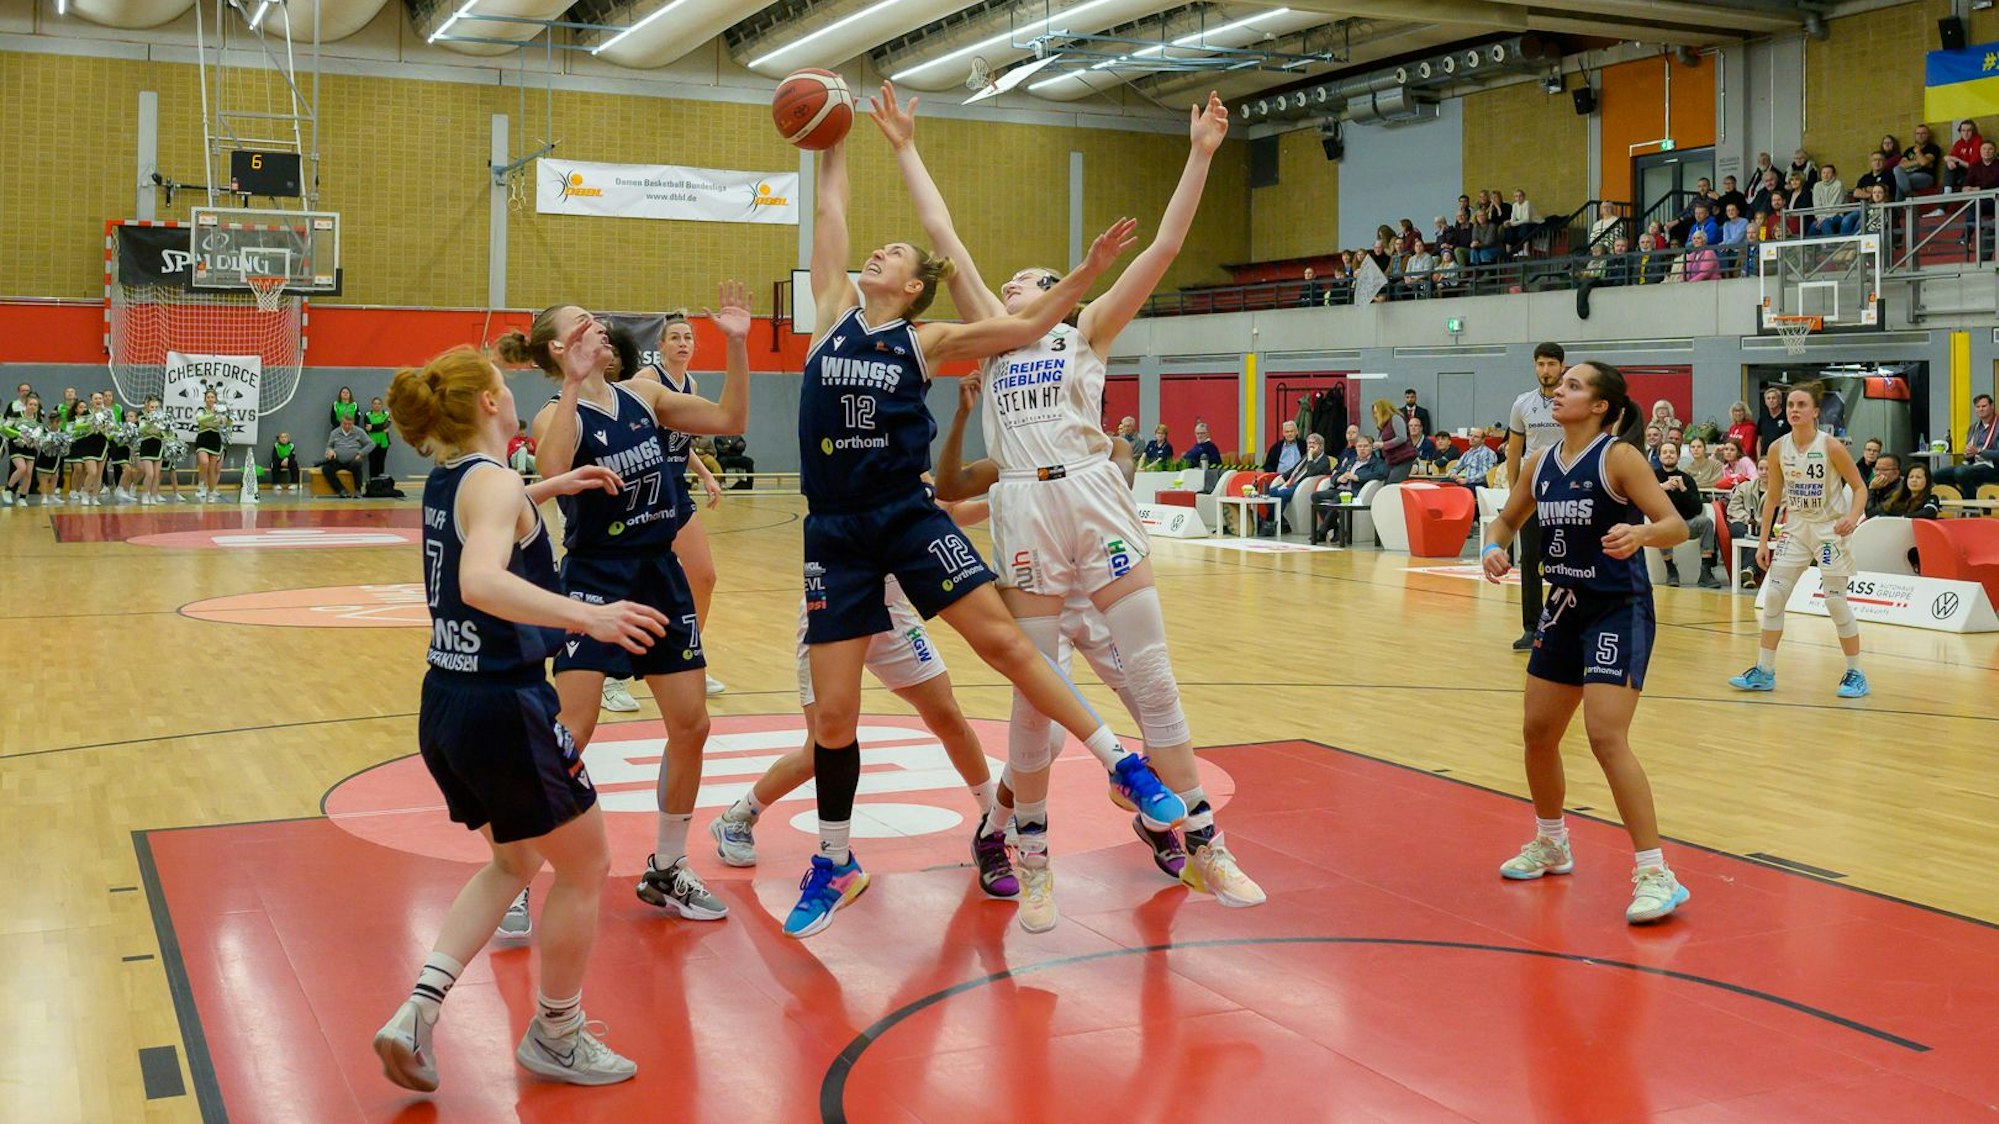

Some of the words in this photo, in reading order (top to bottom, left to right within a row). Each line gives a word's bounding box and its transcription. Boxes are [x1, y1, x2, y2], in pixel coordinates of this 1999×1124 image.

[251, 154, 262, 169] 6
[616, 178, 642, 186] Damen
[644, 179, 684, 188] Basketball
[686, 181, 727, 192] Bundesliga
[646, 193, 697, 202] www.dbbl.de
[1051, 338, 1066, 351] 3
[168, 362, 258, 388] CHEERFORCE
[821, 356, 903, 386] WINGS
[1009, 359, 1065, 375] REIFEN
[821, 377, 897, 393] LEVERKUSEN
[993, 370, 1062, 393] STIEBLING
[841, 394, 876, 430] 12
[998, 389, 1037, 415] STEIN
[1043, 386, 1060, 407] HT
[669, 432, 690, 452] 27
[836, 433, 889, 449] orthoml
[595, 436, 662, 473] WINGS
[1806, 464, 1824, 478] 43
[624, 471, 661, 511] 77
[1537, 498, 1594, 520] WINGS
[928, 534, 976, 574] 12
[1549, 529, 1566, 557] 5
[1822, 541, 1831, 566] HGW
[426, 539, 443, 608] 7
[1544, 563, 1596, 579] orthomol
[1877, 590, 1914, 600] GRUPPE
[432, 618, 481, 653] NGS
[906, 627, 932, 664] HGW
[1595, 632, 1619, 665] 5
